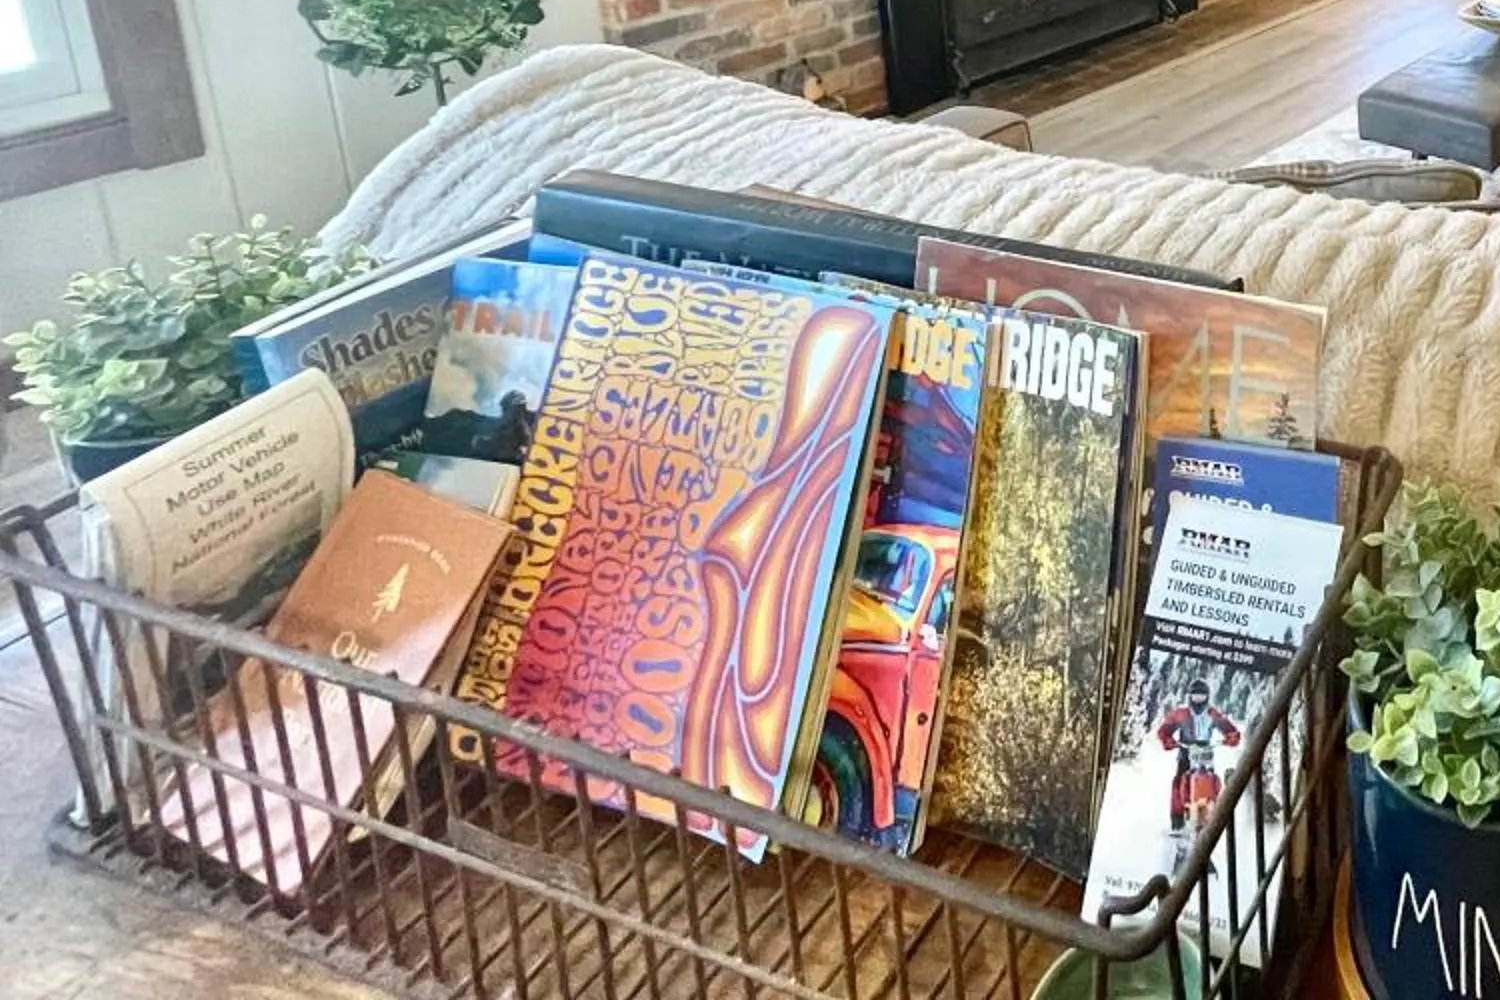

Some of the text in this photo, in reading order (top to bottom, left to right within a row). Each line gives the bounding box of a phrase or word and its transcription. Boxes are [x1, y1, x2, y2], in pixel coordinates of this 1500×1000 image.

[301, 304, 437, 374] Shades
[451, 301, 555, 343] TRAIL
[602, 272, 683, 378] BLUE
[675, 281, 762, 394] RIVER
[181, 427, 266, 478] Summer
[486, 258, 640, 608] BRECKENRIDGE
[165, 432, 299, 513] Motor Vehicle
[197, 461, 285, 516] Use Map
[189, 474, 301, 544] White River
[172, 517, 254, 574] National
[1167, 577, 1306, 619] TIMBERSLED RENTALS
[1170, 559, 1297, 596] GUIDED & UNGUIDED
[1162, 597, 1249, 627] AND LESSONS
